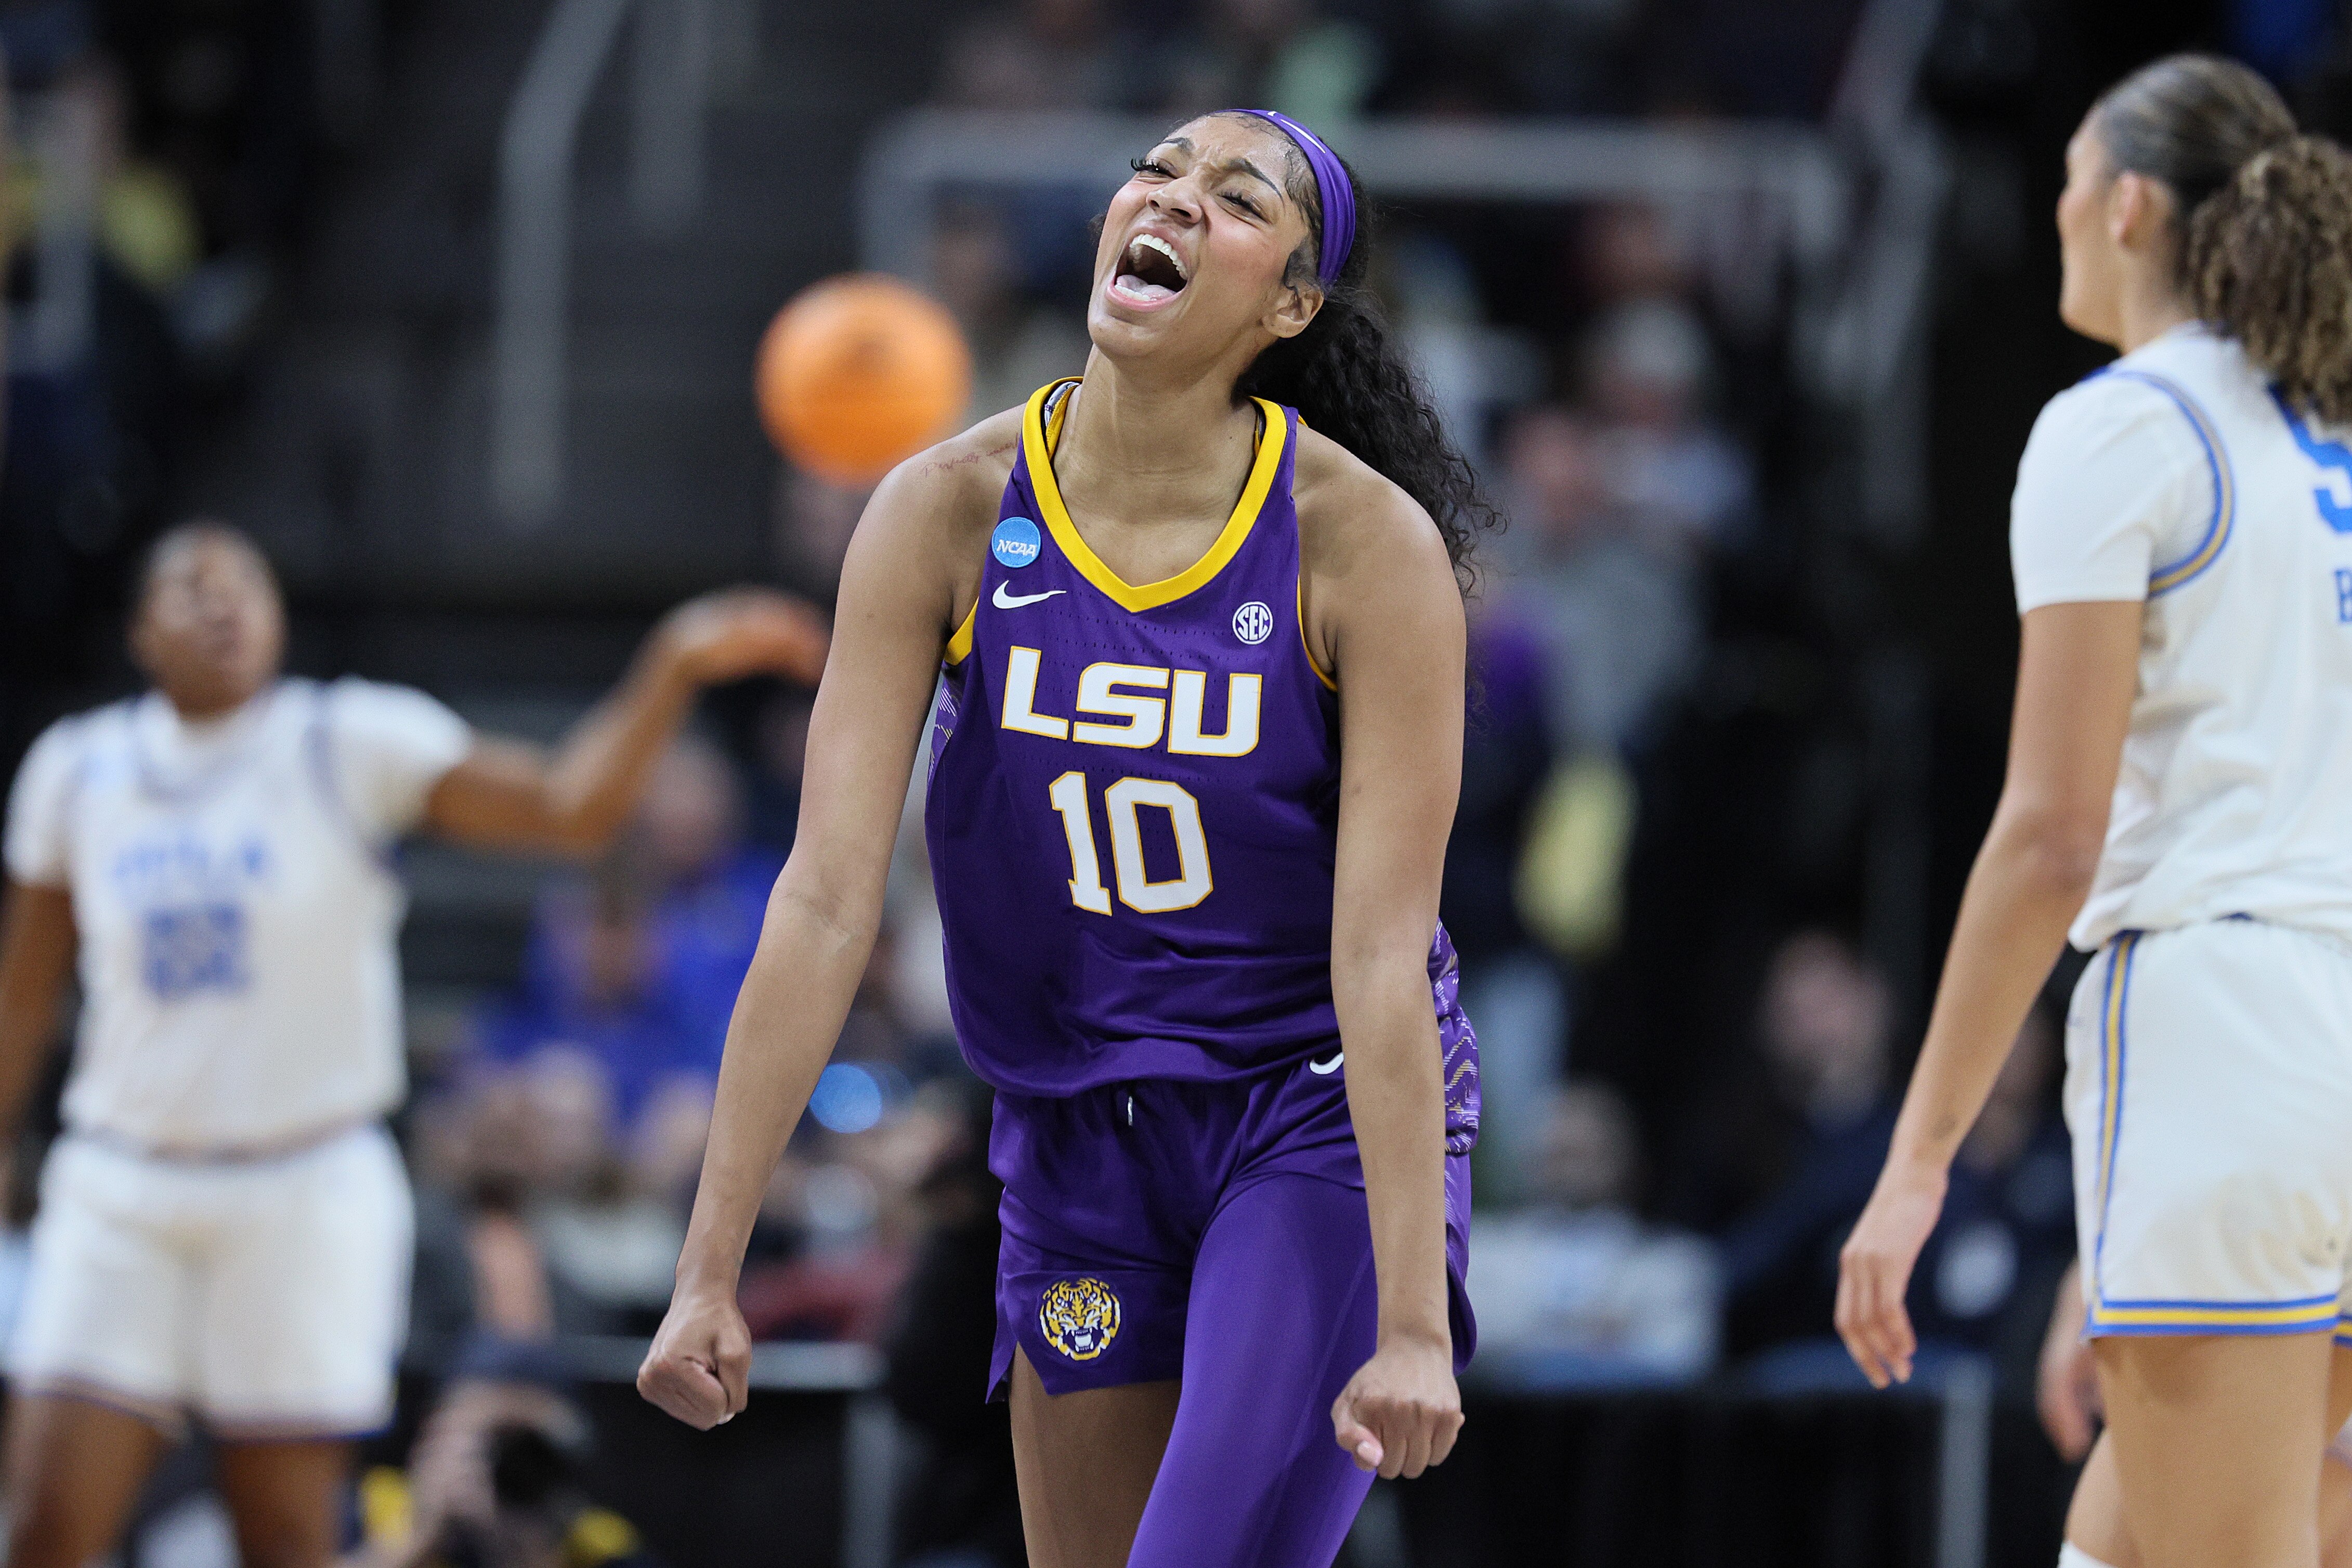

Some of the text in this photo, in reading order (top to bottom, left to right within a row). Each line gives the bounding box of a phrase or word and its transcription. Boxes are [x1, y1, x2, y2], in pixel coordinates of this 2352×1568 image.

[996, 539, 1037, 558] NCAA
[1237, 605, 1269, 641] SEC
[1001, 645, 1262, 757] LSU
[1049, 770, 1214, 917] 10
